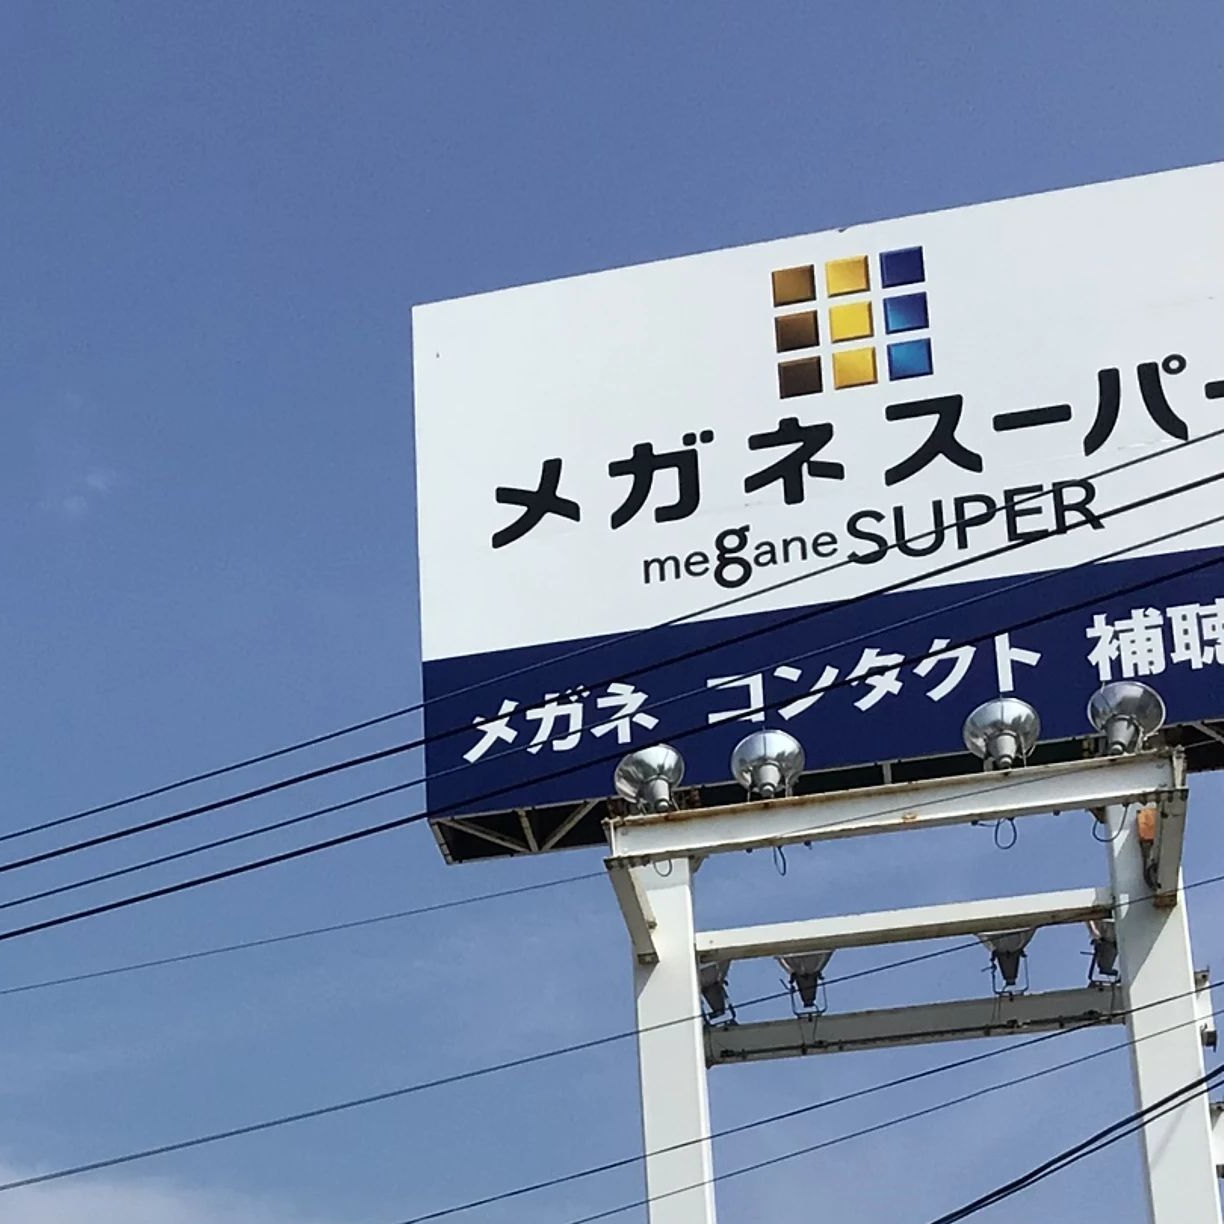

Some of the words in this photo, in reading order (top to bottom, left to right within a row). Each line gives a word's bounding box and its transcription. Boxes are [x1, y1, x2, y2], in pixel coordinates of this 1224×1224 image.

[492, 354, 1224, 548] メガネスーパ
[463, 683, 659, 763] メガネ
[707, 632, 1041, 726] コンタクト
